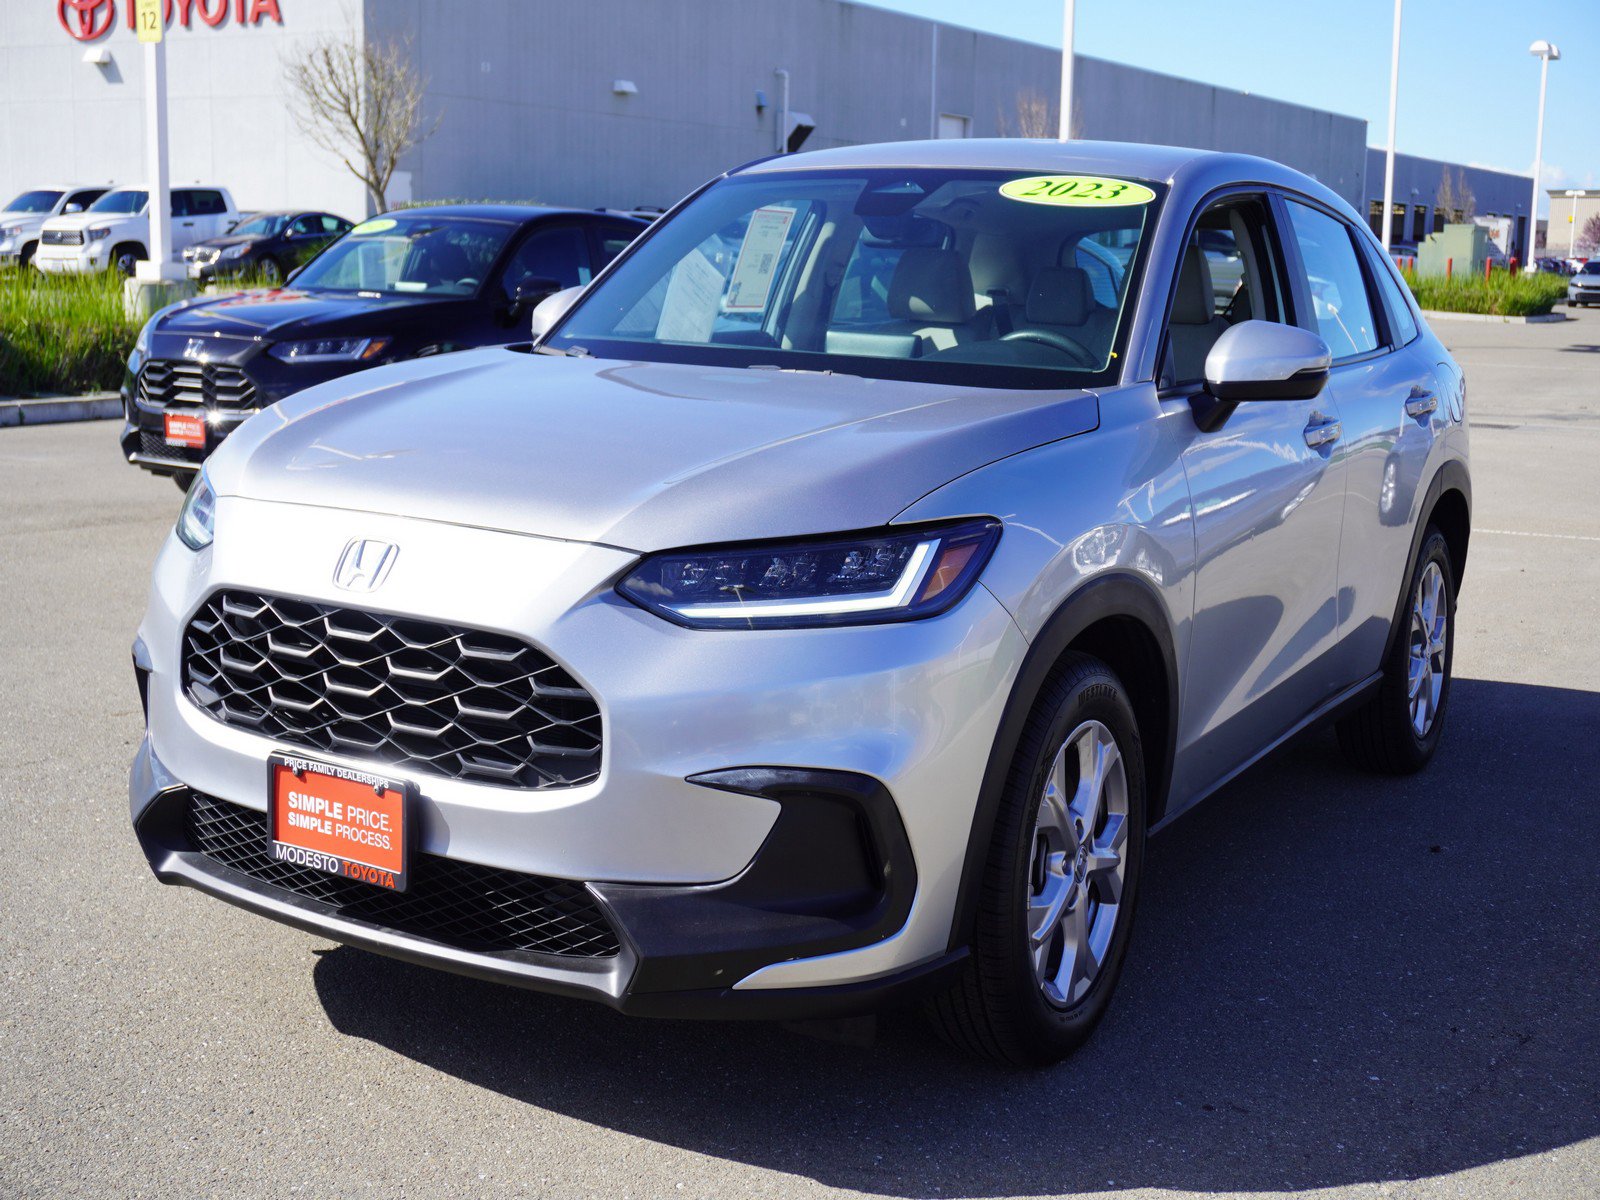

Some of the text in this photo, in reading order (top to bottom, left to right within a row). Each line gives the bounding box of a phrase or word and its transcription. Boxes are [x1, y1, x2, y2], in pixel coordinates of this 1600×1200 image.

[141, 11, 157, 30] 12
[1020, 180, 1129, 199] 2023
[284, 758, 389, 789] PRICE FAMILY DEALERSHIPS
[288, 791, 393, 833] SIMPLE PRICE.
[288, 811, 393, 850] SIMPLE PROCESS.
[275, 844, 396, 889] MODESTO TOYOTA
